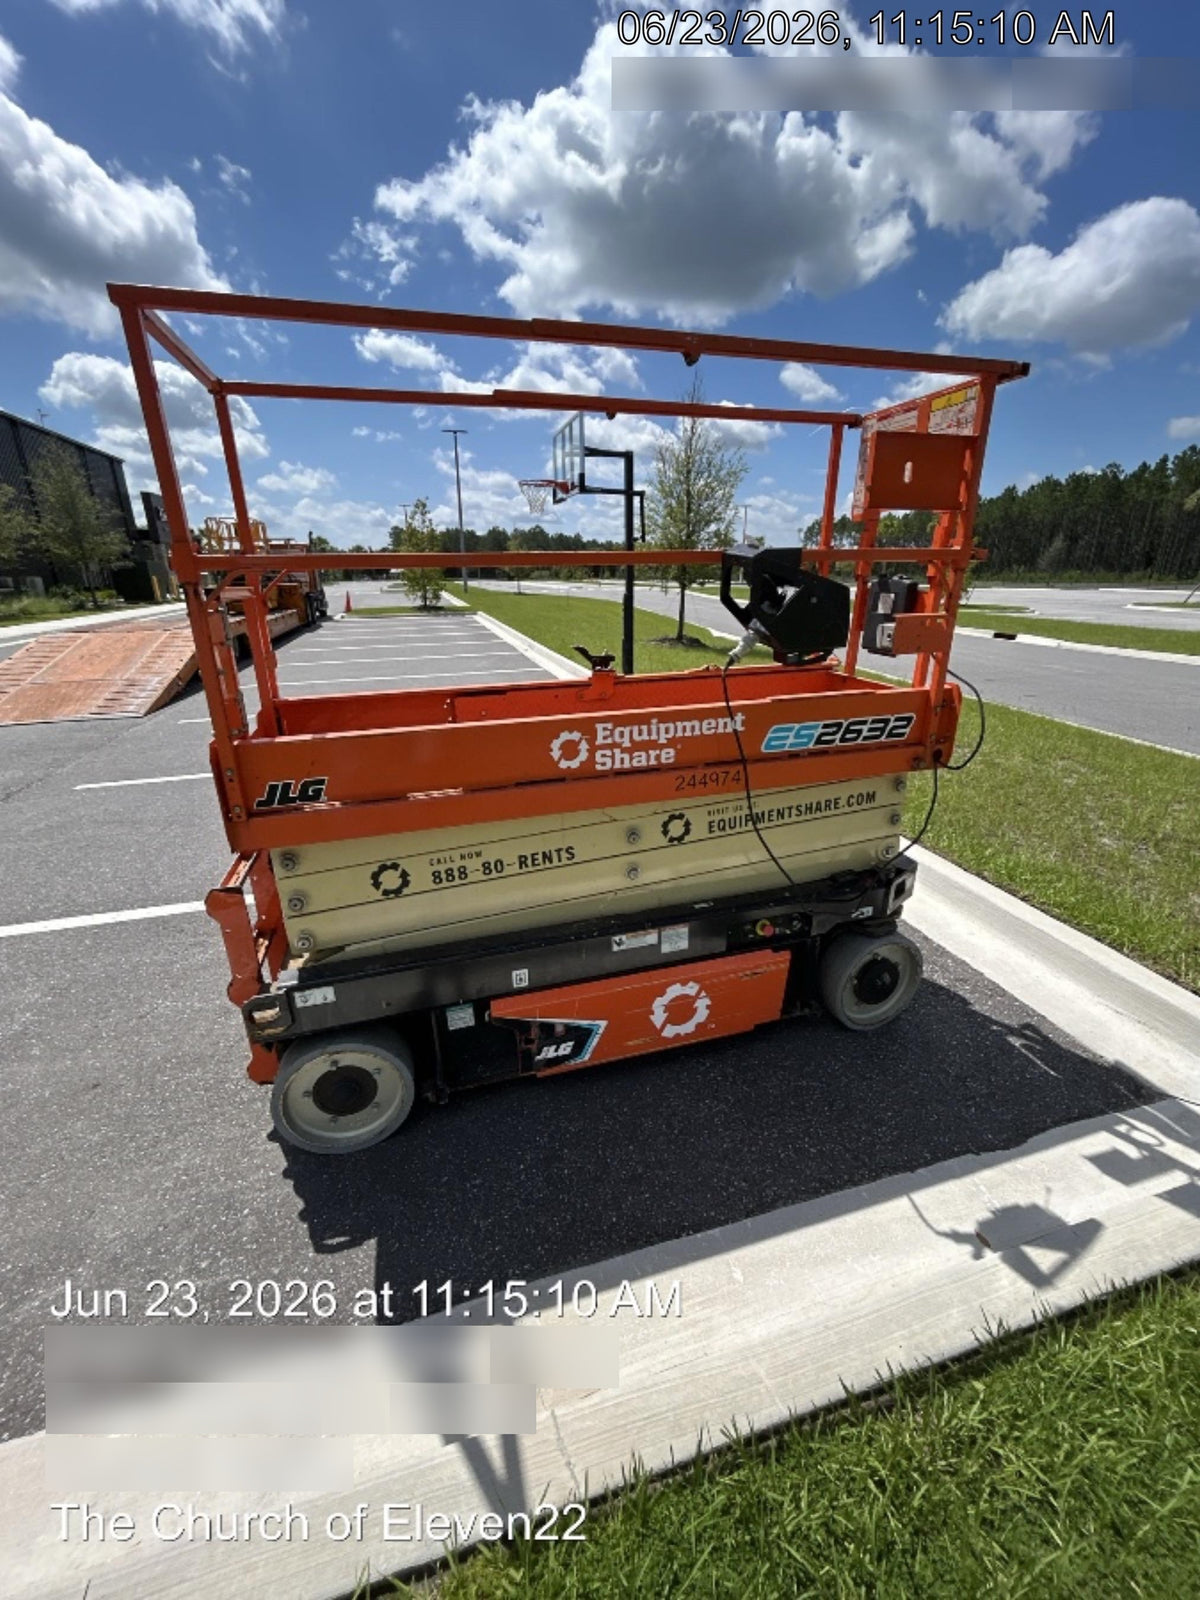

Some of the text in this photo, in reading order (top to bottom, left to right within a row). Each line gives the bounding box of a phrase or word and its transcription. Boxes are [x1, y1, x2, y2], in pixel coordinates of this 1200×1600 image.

[595, 712, 746, 748] Equipment
[761, 713, 916, 753] ES2632
[595, 747, 677, 771] Share
[254, 776, 329, 810] JLG
[674, 769, 741, 793] 244974
[708, 790, 876, 834] EQUIPMENTSHARE.COM
[428, 850, 483, 867] CALL NOW
[534, 1041, 575, 1062] JLG
